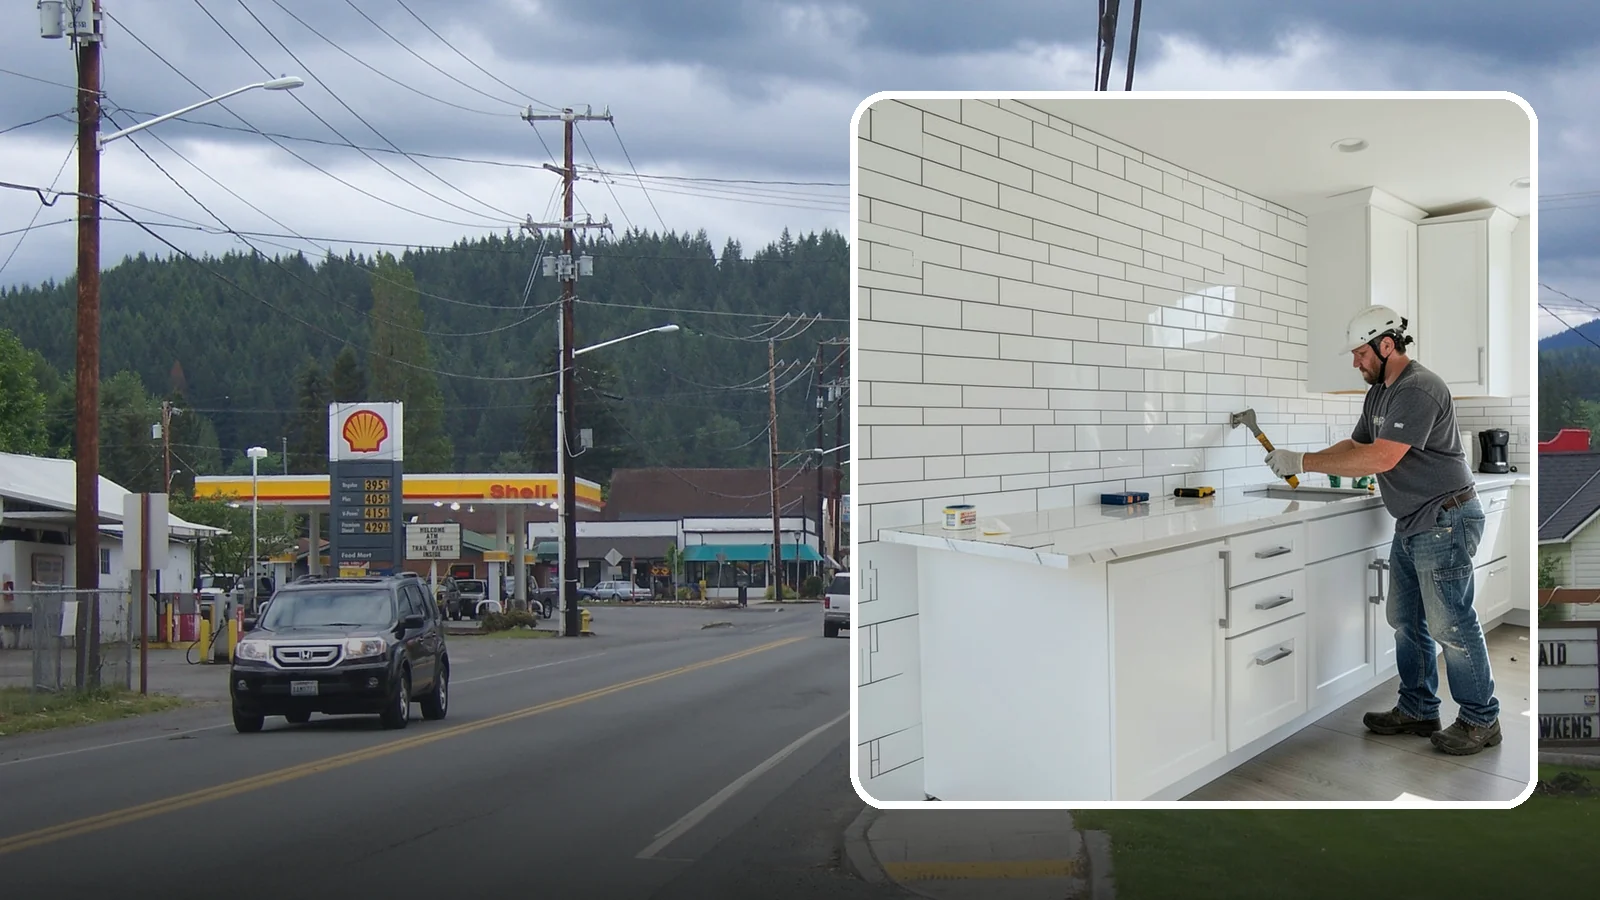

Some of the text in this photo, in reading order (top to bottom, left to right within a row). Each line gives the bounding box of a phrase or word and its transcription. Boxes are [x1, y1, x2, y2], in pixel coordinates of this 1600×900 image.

[366, 480, 384, 490] 395
[490, 484, 547, 499] Shell
[366, 494, 384, 504] 405
[366, 508, 384, 518] 415
[366, 522, 384, 532] 429
